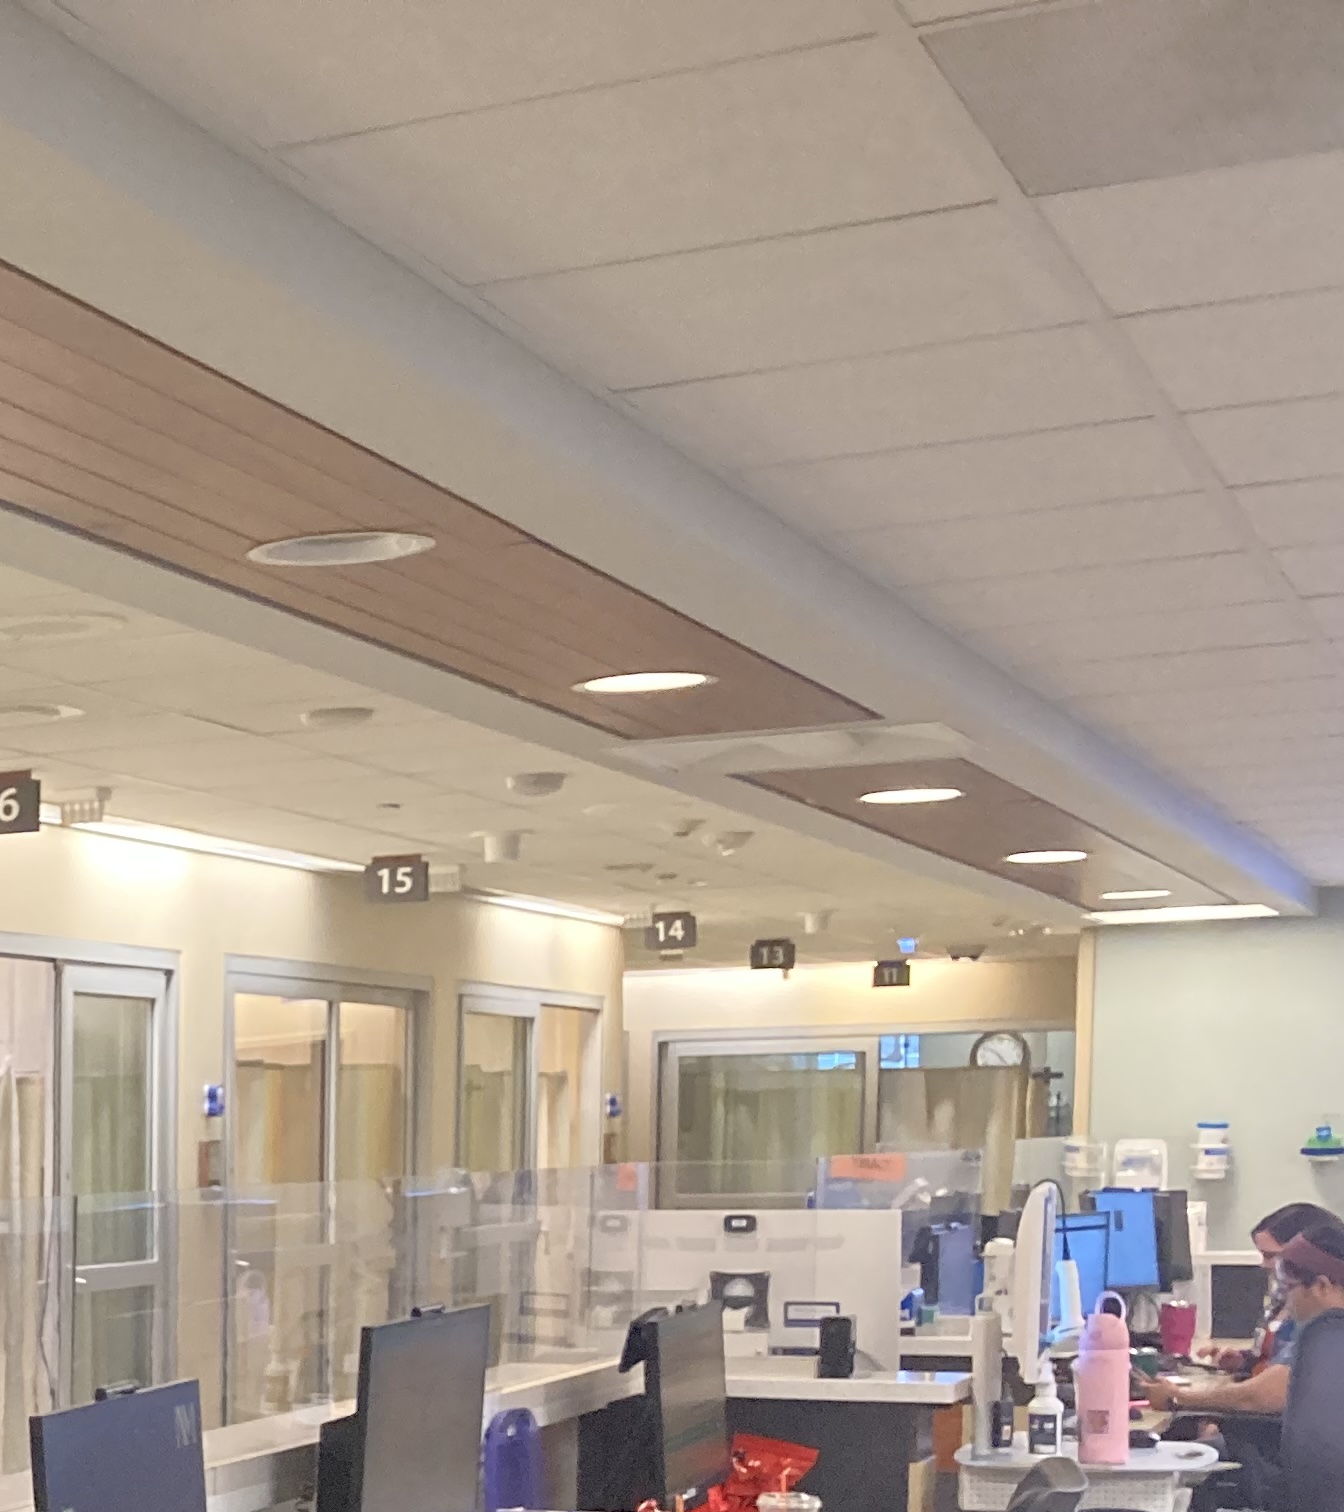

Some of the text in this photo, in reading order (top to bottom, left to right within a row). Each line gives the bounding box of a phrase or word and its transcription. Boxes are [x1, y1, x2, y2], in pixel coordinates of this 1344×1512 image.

[376, 866, 413, 894] 15
[654, 919, 685, 942] 14
[761, 947, 785, 965] 13
